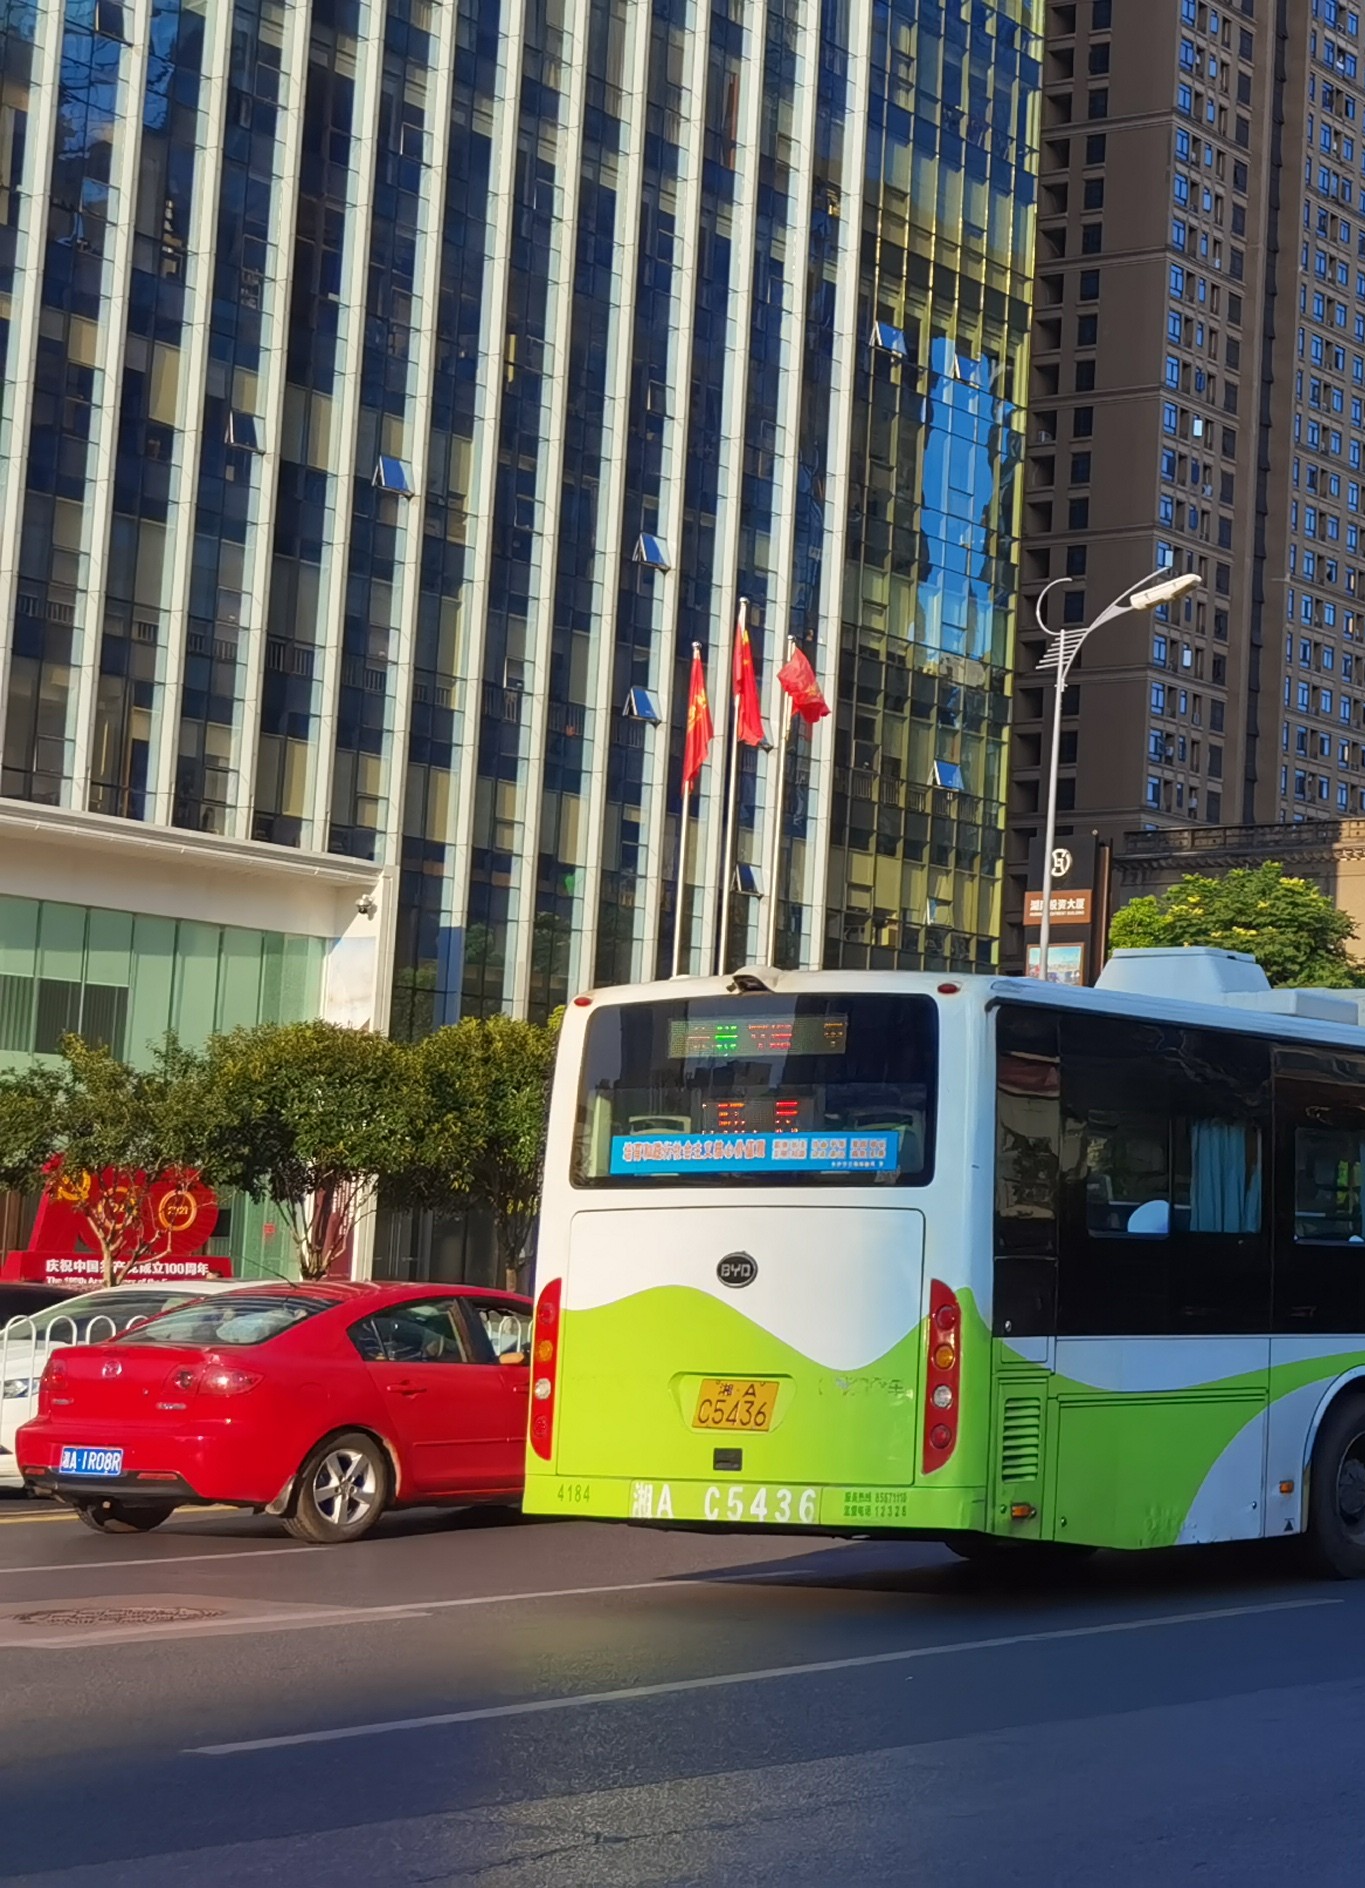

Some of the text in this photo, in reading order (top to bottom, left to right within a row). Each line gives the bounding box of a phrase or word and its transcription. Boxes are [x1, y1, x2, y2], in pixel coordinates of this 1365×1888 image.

[46, 1260, 208, 1275] 庆祝中国产成立100周年
[720, 1263, 752, 1278] BYD
[697, 1399, 767, 1427] C5436
[557, 1485, 590, 1502] 4184
[704, 1486, 816, 1524] C5436
